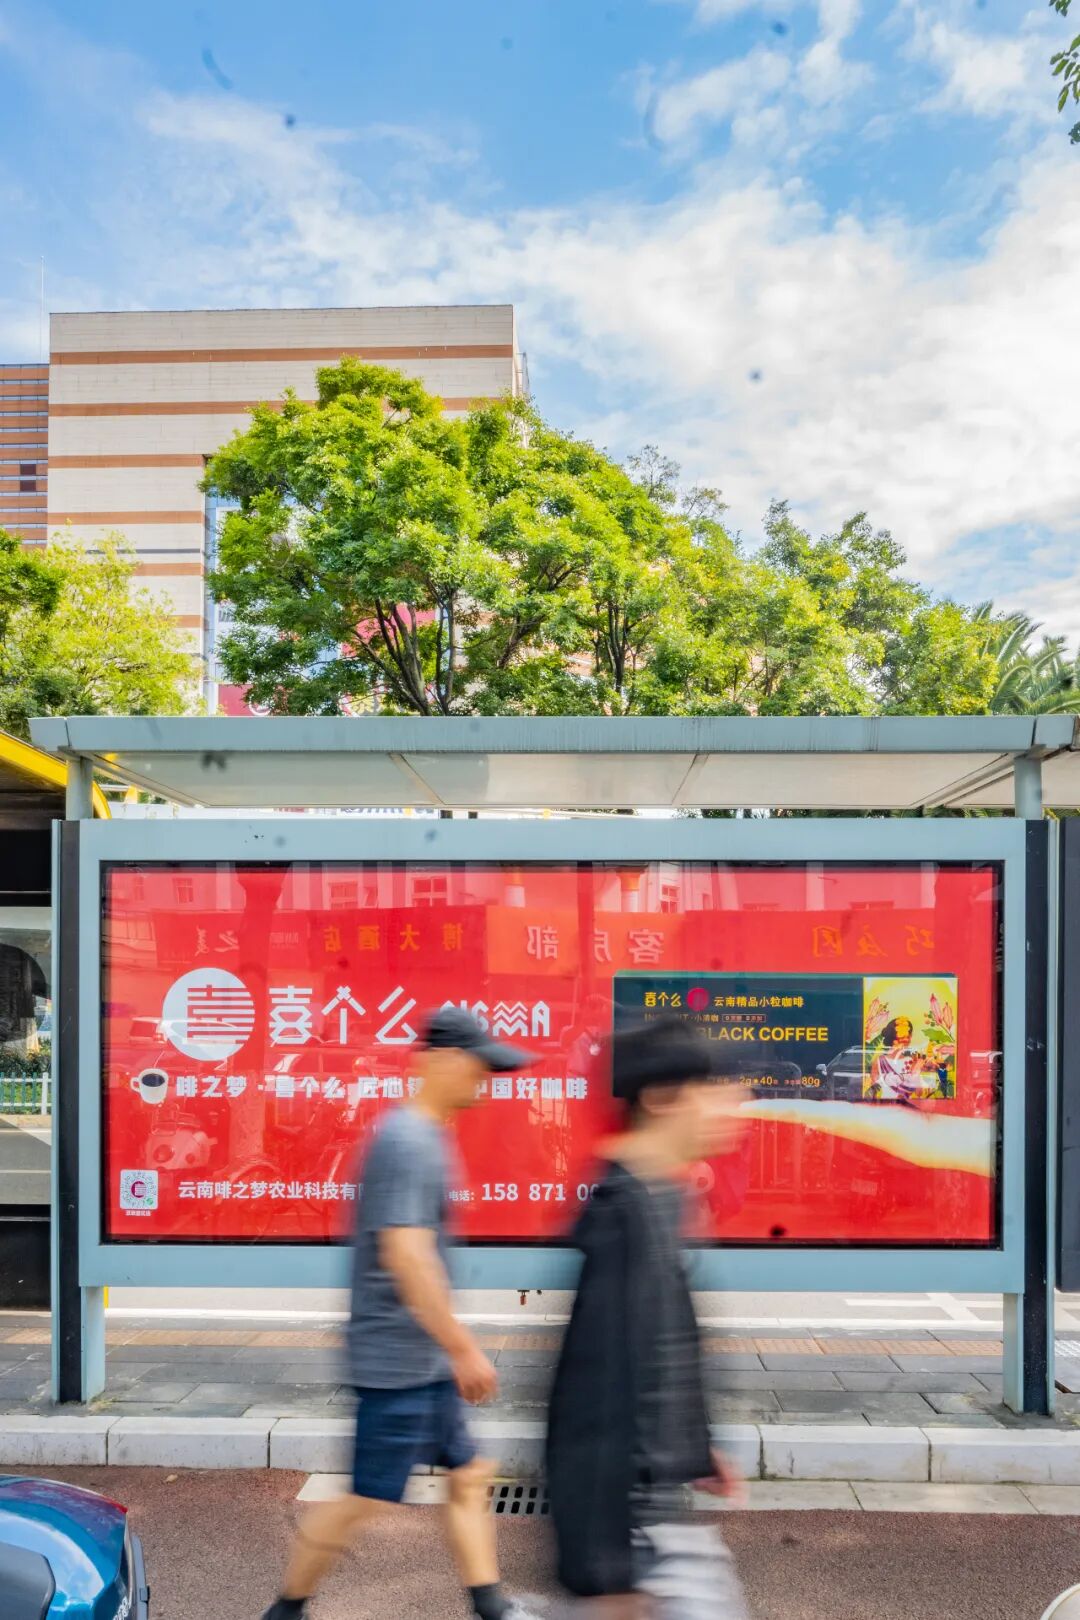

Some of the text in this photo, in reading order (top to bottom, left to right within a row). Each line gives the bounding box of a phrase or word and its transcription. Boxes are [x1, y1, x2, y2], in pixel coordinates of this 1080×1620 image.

[644, 992, 682, 1008] 喜个么
[269, 985, 418, 1045] 喜个么
[758, 1027, 829, 1042] COFFEE
[178, 1180, 364, 1201] 云南啡之梦农业科技有
[481, 1183, 519, 1201] 158
[528, 1183, 566, 1201] 871
